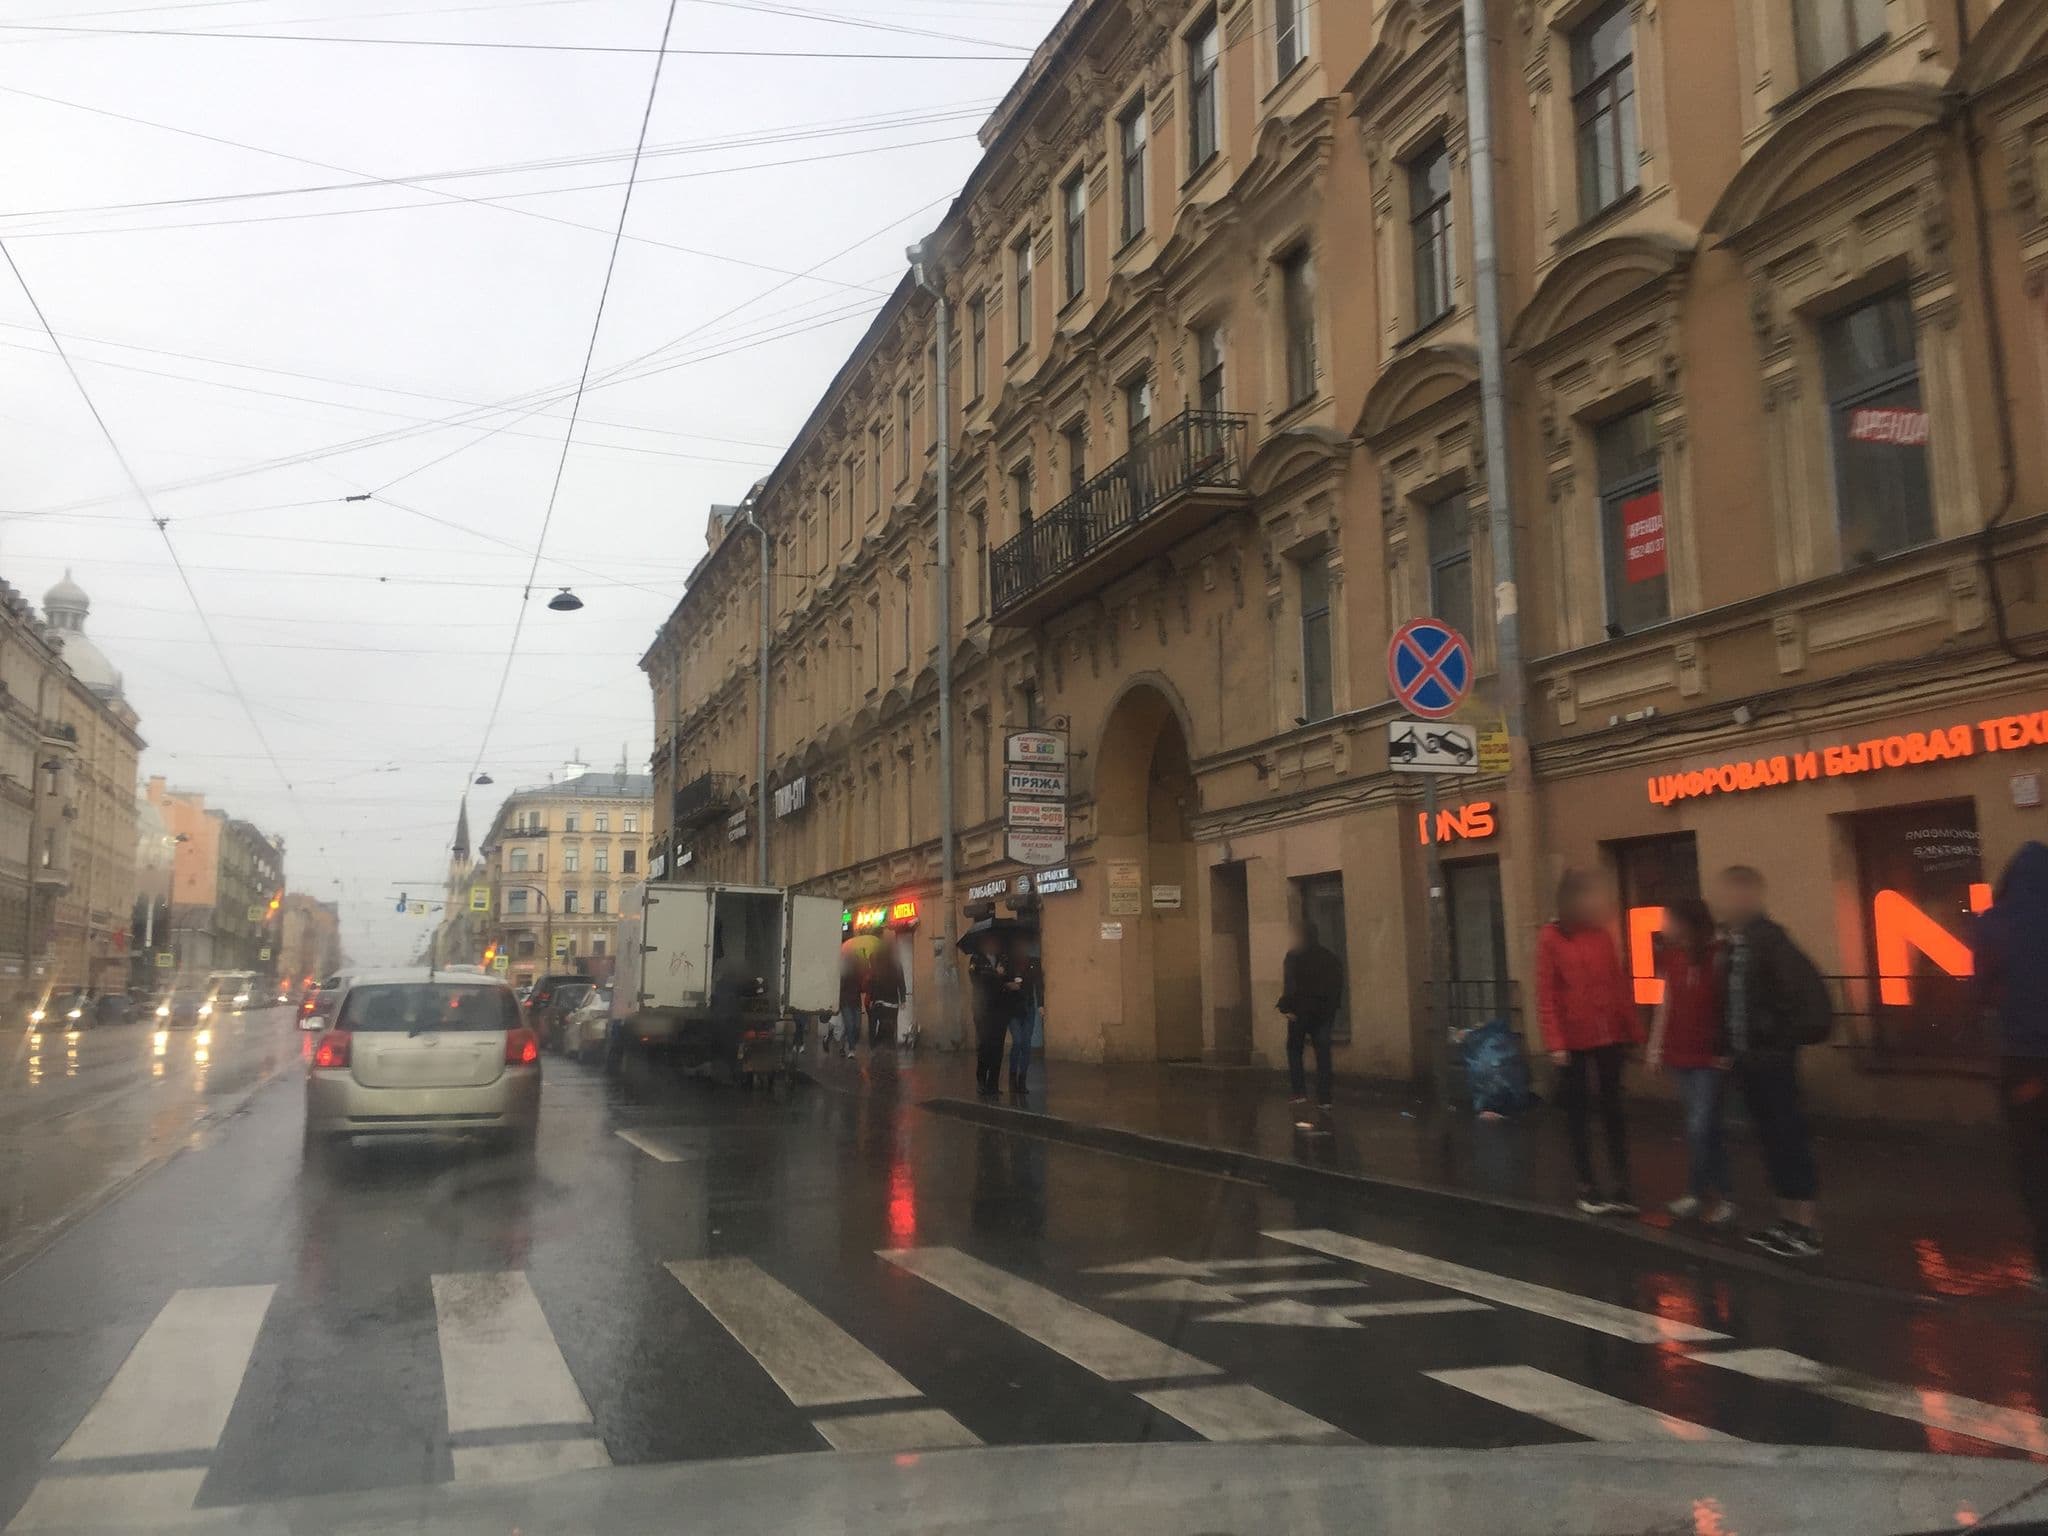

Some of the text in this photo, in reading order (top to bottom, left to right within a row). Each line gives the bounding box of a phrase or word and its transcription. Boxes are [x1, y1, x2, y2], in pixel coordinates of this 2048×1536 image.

[1647, 709, 2048, 806] ЦИФРОВАЯ И БЫТОВАЯ ТЕХ
[1012, 776, 1061, 790] ПРЯЖА
[1041, 813, 1063, 822] ФОТО
[1418, 801, 1495, 846] DNS
